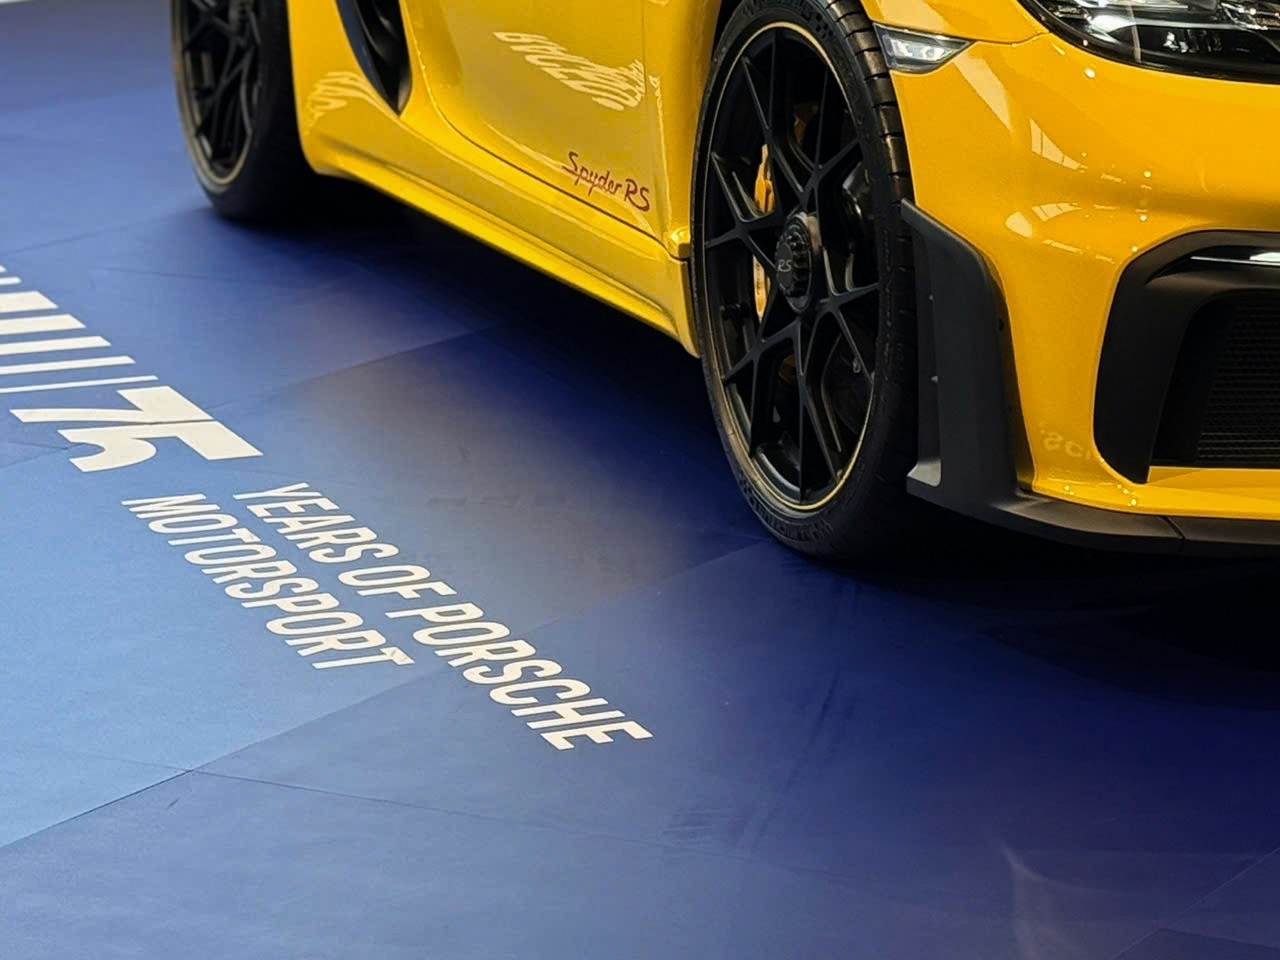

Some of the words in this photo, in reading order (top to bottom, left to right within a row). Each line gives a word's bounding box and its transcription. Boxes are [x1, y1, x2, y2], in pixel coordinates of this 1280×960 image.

[562, 151, 622, 196] Spyder
[624, 178, 650, 211] RS
[10, 386, 263, 472] 75
[233, 483, 399, 563] YEARS
[121, 494, 415, 669] MOTORSPORT
[338, 565, 457, 599] OF
[385, 603, 653, 750] PORSCHE
